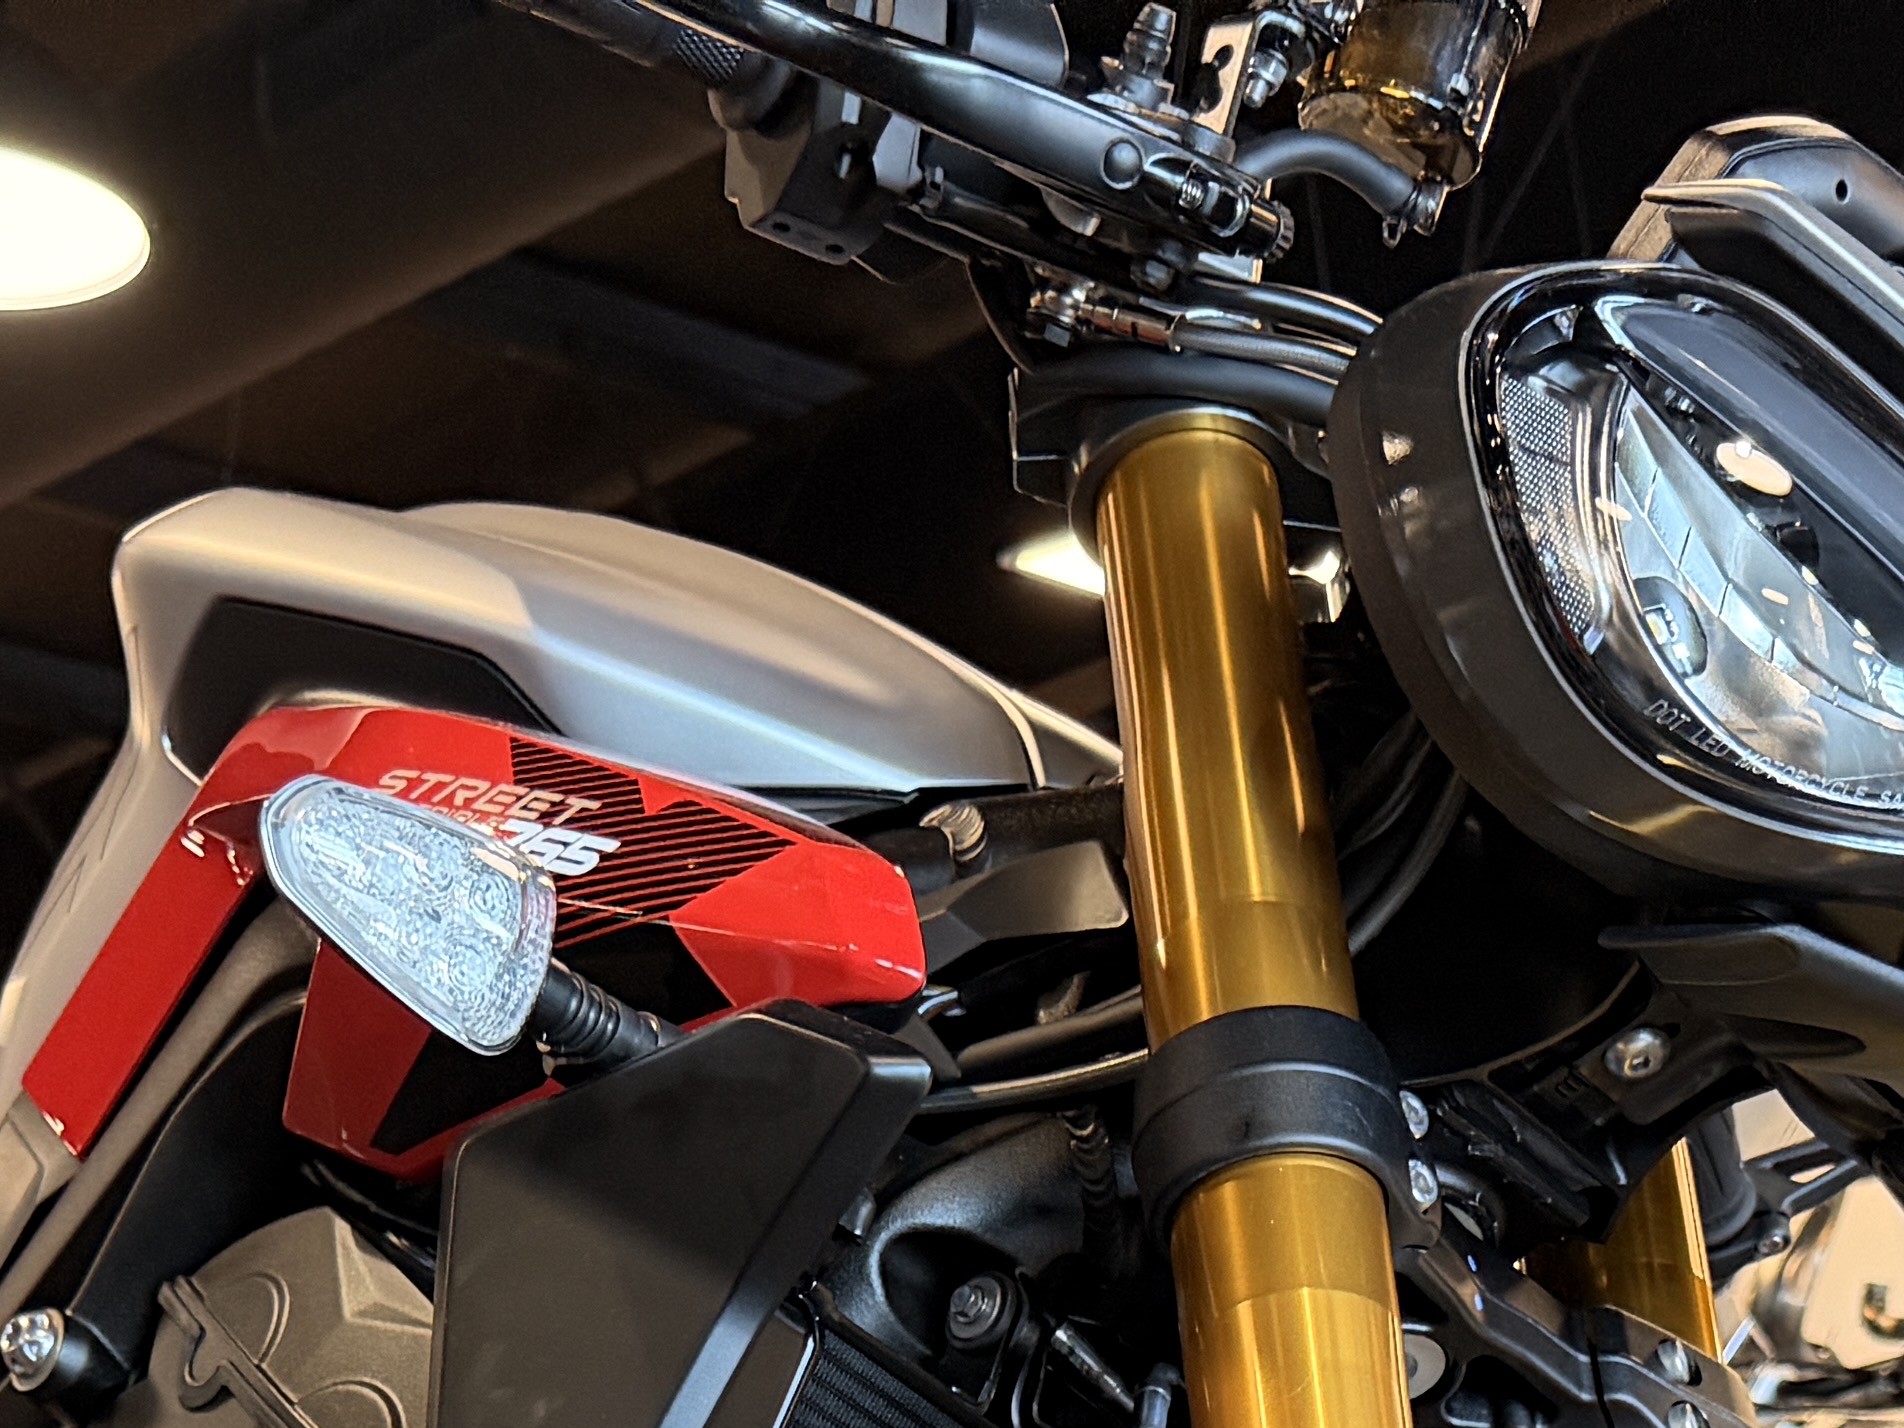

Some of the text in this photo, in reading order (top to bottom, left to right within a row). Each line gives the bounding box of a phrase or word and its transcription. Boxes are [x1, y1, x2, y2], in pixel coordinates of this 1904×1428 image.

[1644, 698, 1691, 731] DOT
[1692, 727, 1732, 757] LED
[374, 769, 602, 825] STREET
